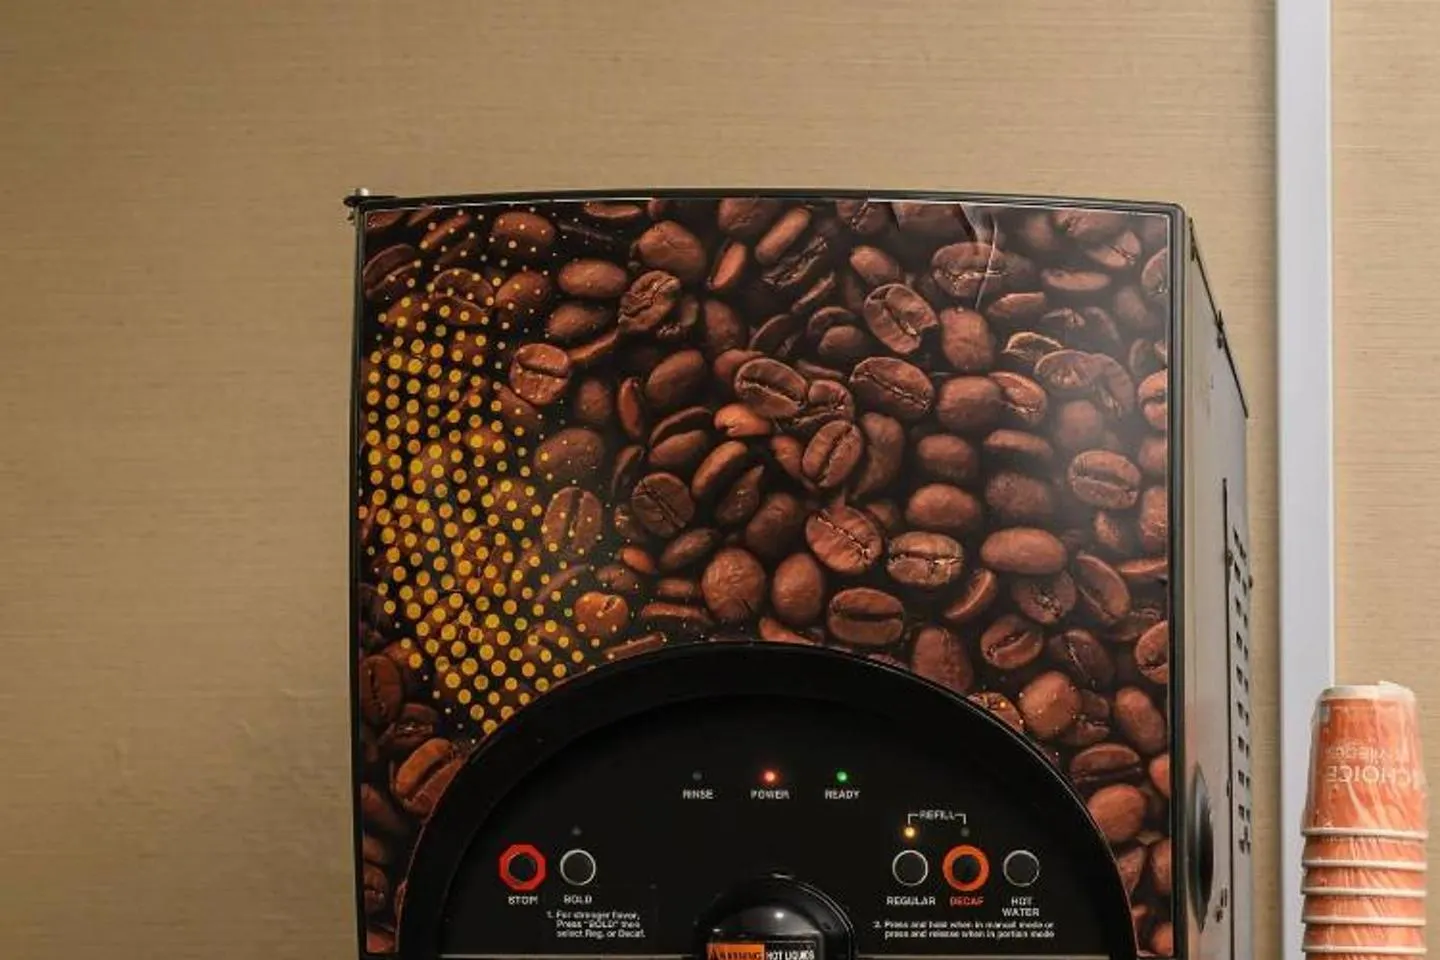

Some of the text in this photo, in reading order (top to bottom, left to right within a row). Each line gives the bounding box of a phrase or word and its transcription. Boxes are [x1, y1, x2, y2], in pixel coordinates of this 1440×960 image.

[683, 789, 714, 799] RINSE
[750, 789, 790, 799] POWER
[825, 789, 860, 799] READY
[919, 810, 954, 820] REFILL
[508, 895, 538, 905] STOP
[564, 894, 593, 904] BOLD
[886, 896, 936, 906] REGULAR
[950, 896, 984, 906] DECAF
[1011, 896, 1033, 906] HOT
[1002, 907, 1040, 917] WATER
[765, 950, 783, 960] HOT
